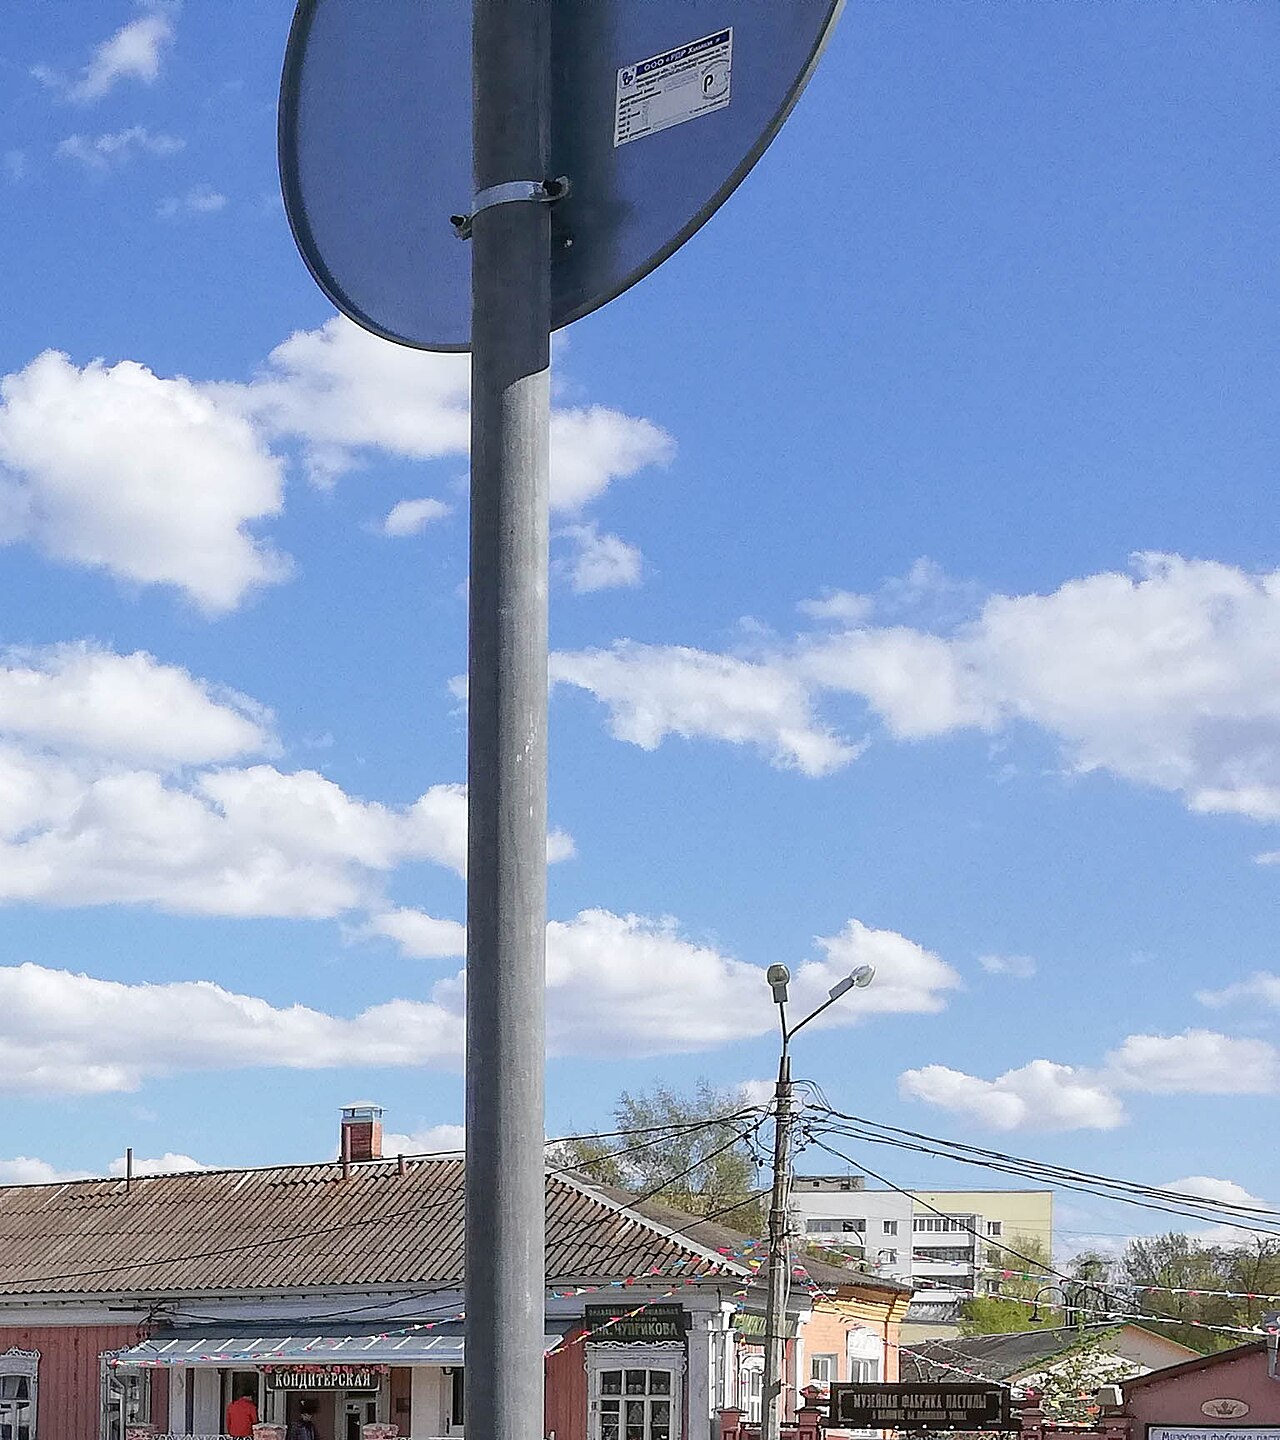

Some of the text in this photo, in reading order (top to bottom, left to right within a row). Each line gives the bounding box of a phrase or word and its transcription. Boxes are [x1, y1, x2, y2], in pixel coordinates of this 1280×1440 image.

[614, 1322, 678, 1336] ЧУПРИКОВА
[275, 1372, 371, 1389] КОНДИТЕРСКАЯ
[853, 1392, 987, 1409] МУЗЕЙНАЯ ФАБРИКА ПАСТИЛЫ
